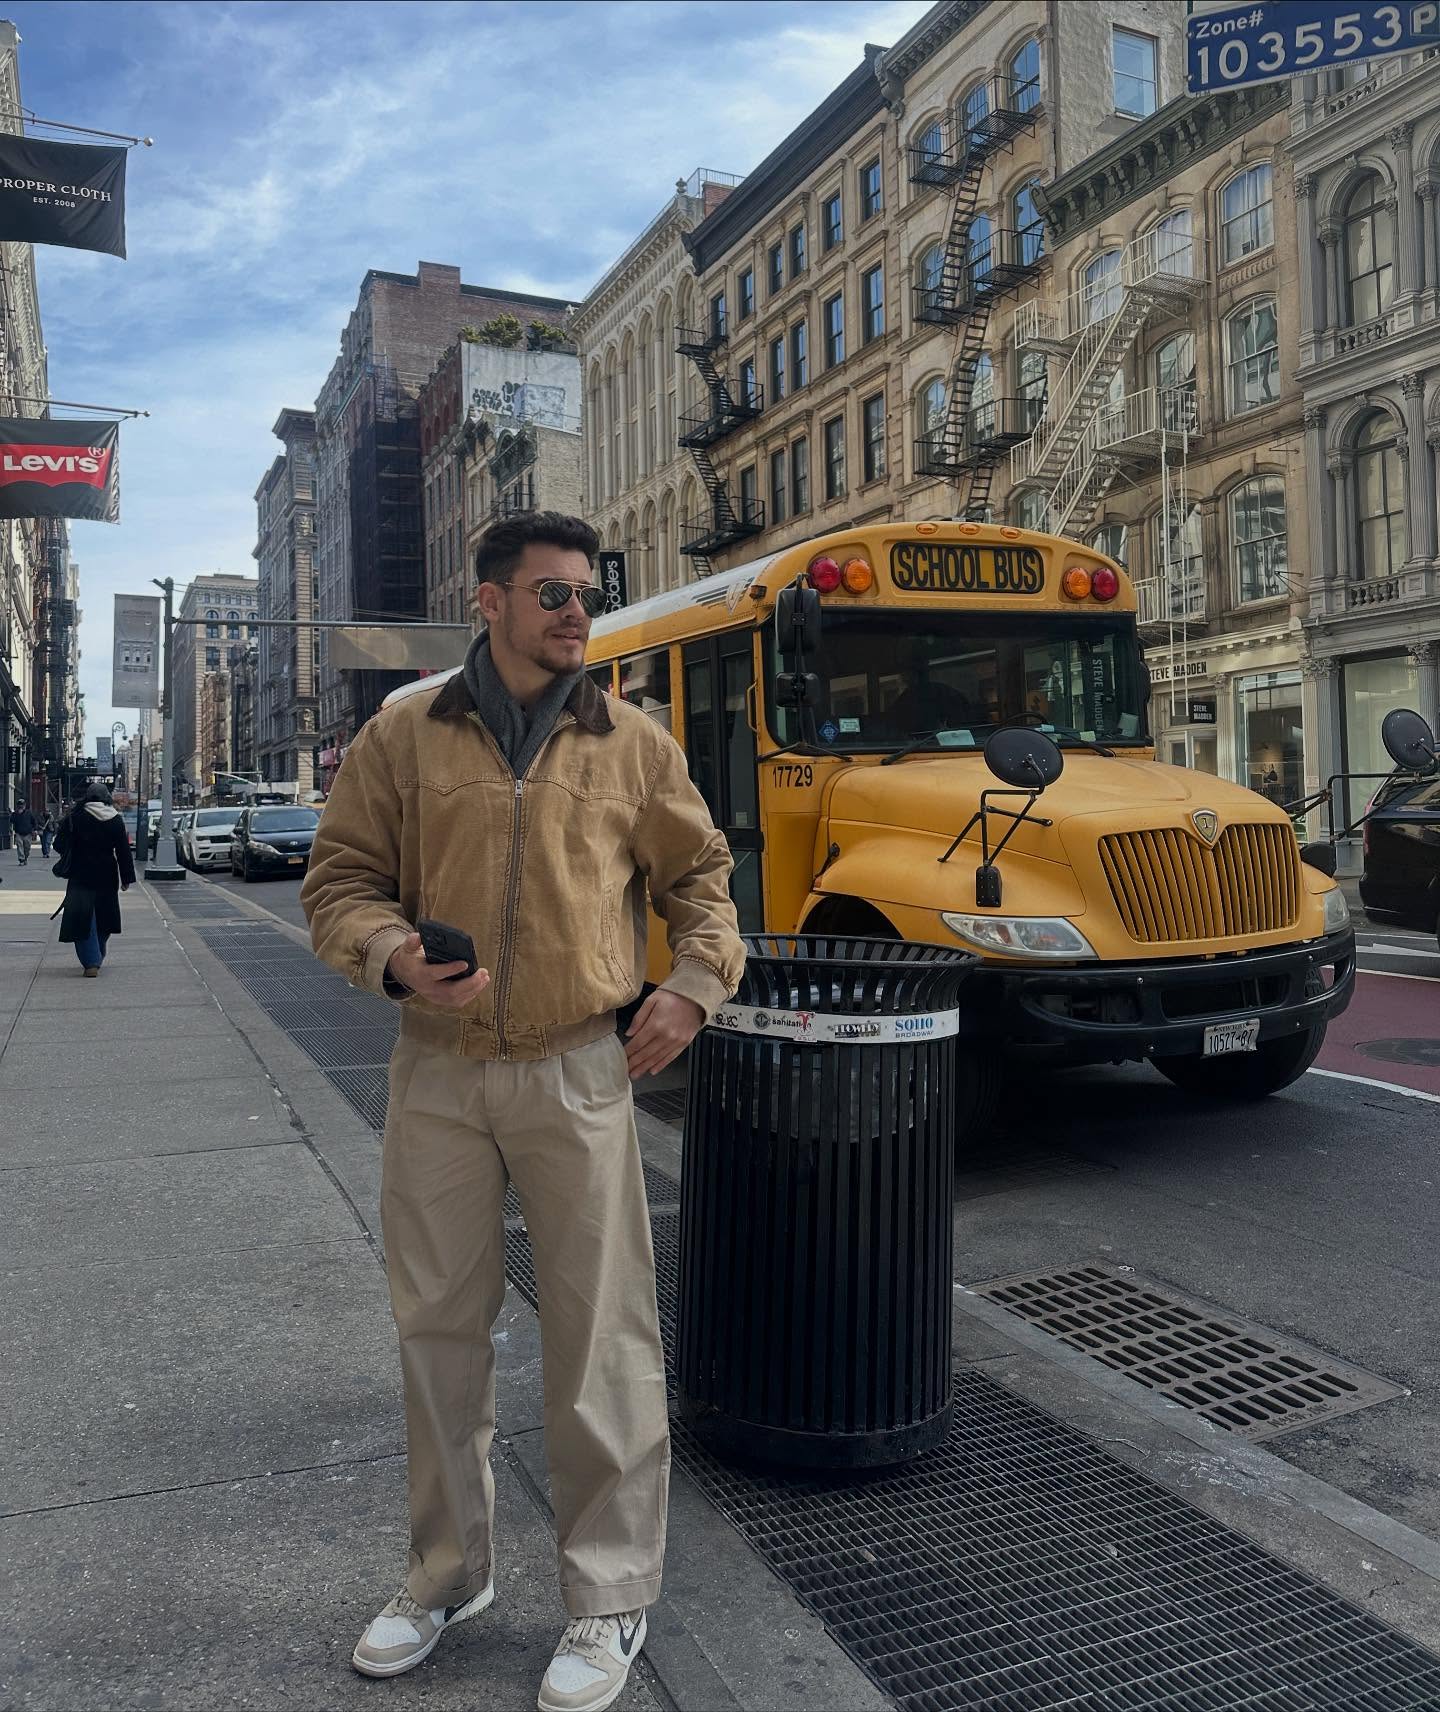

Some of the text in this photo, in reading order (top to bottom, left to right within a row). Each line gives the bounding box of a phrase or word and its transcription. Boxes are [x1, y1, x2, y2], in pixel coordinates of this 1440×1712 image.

[1195, 10, 1264, 39] Zone#
[1197, 6, 1402, 85] 103553
[0, 178, 112, 202] ROPER CLOTH
[33, 196, 76, 208] EST. 2008
[897, 546, 1038, 591] SCHOOL BUS
[1149, 661, 1207, 681] TEVE MADDEN
[1092, 658, 1105, 731] STEVE MADDEN
[772, 764, 813, 788] 17729
[894, 1017, 933, 1031] SOHO
[895, 1030, 934, 1039] BROADWAY
